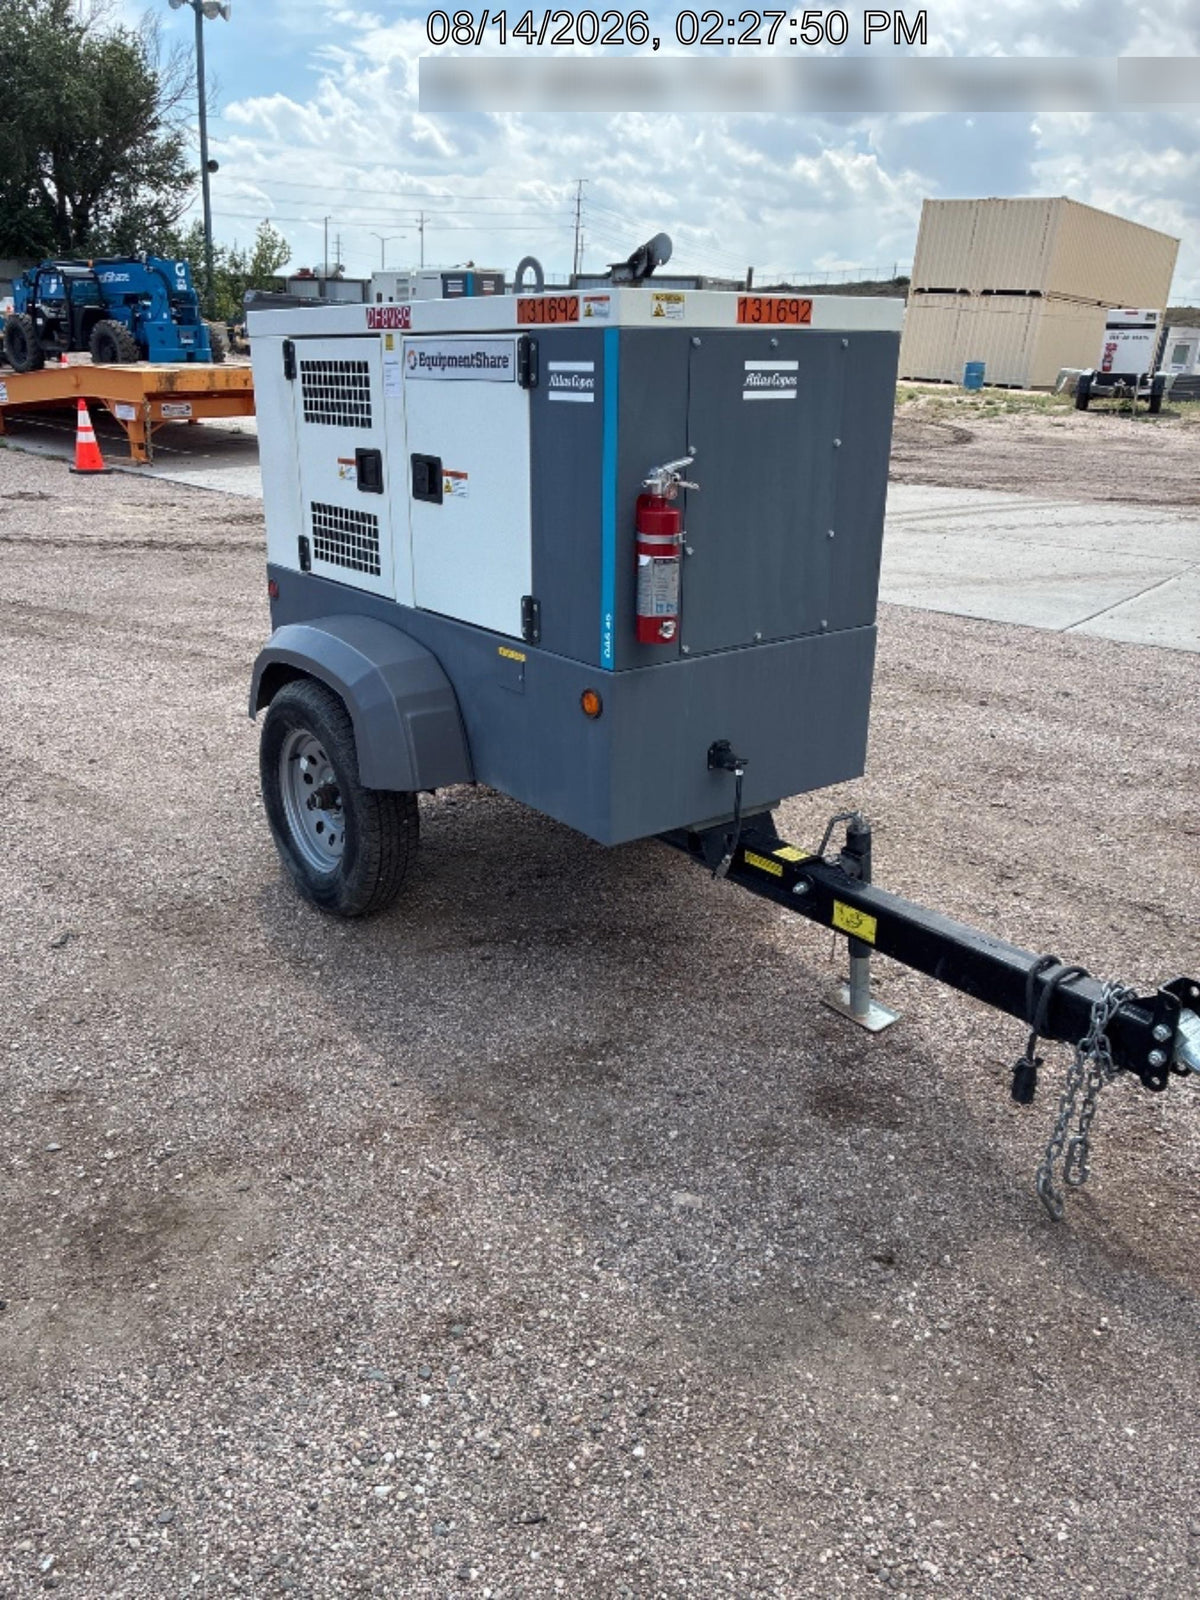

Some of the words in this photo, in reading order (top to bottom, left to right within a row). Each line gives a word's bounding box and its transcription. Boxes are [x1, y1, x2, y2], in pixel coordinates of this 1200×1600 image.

[517, 296, 579, 323] 131692
[738, 298, 813, 323] 131692
[418, 351, 510, 371] EquipmentShare
